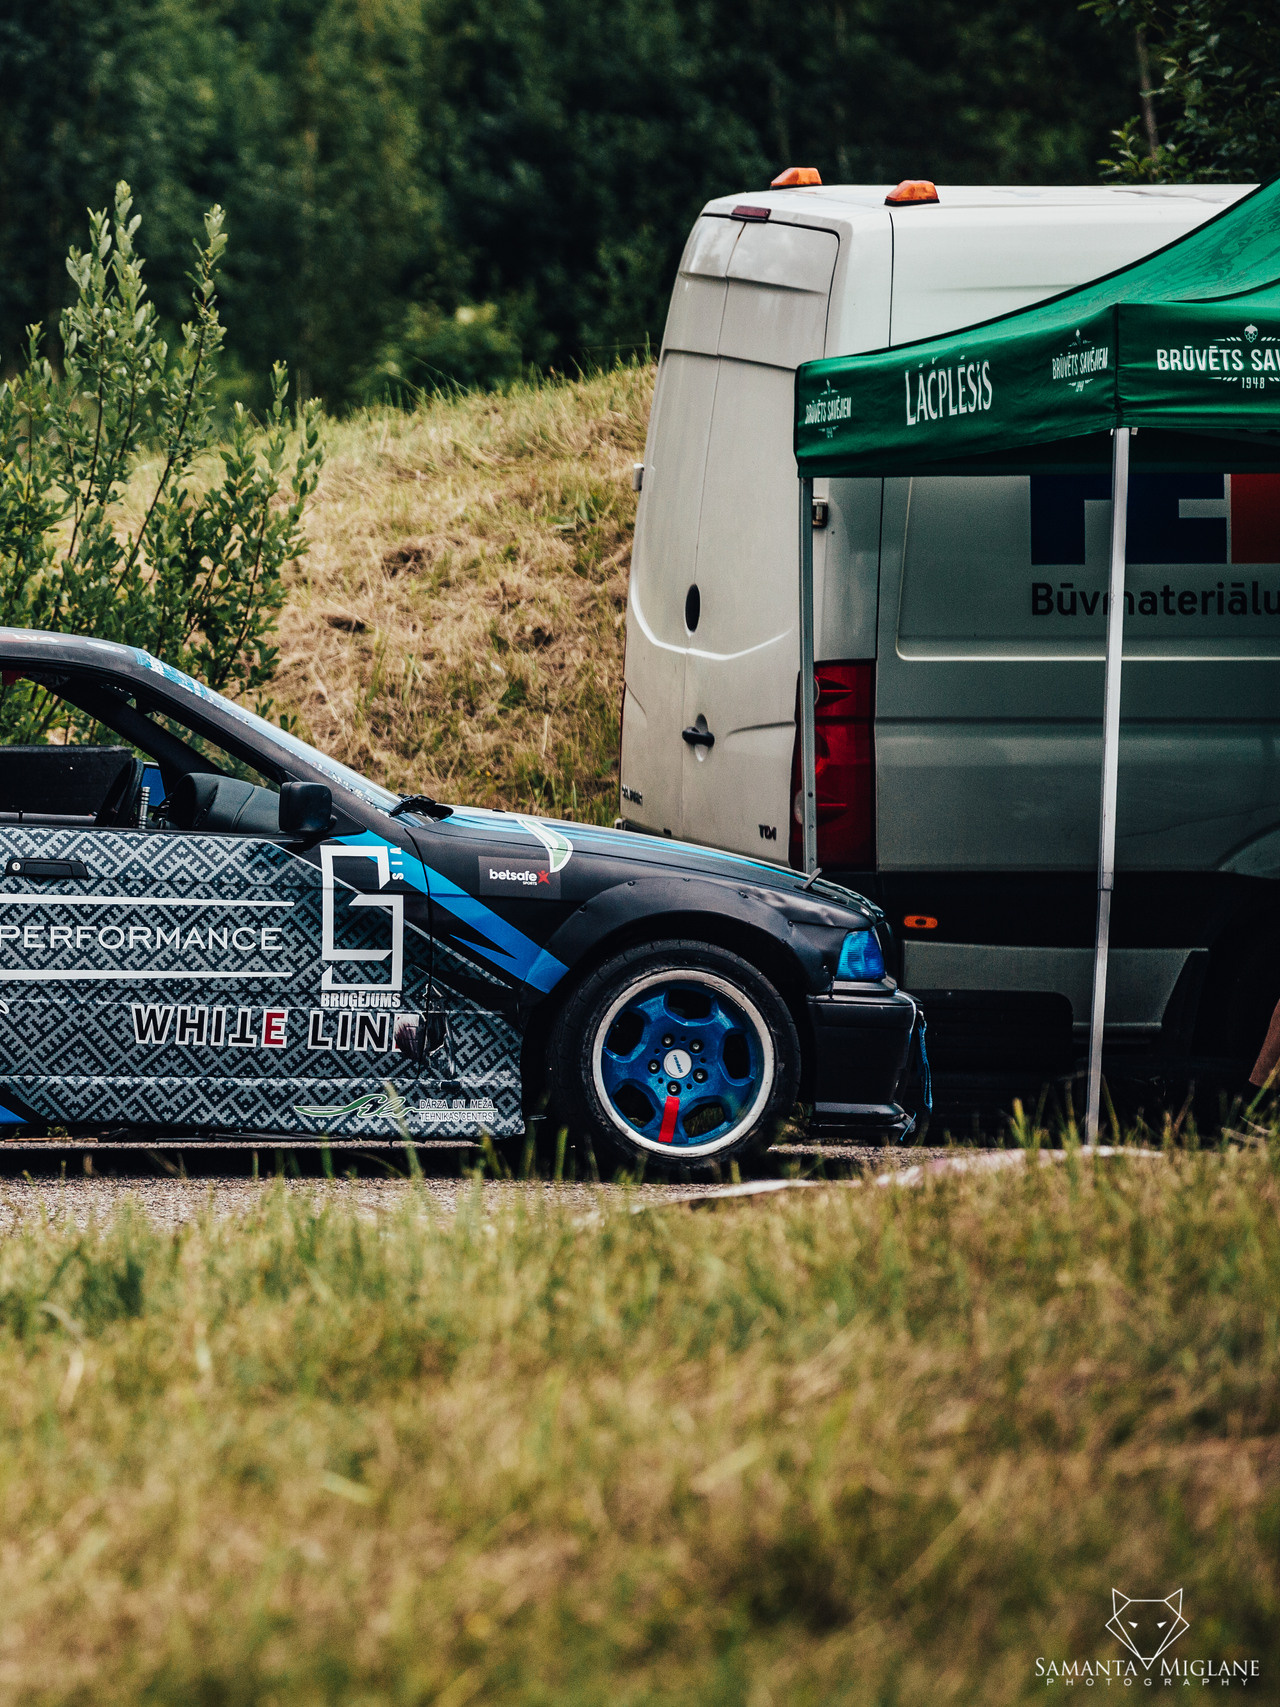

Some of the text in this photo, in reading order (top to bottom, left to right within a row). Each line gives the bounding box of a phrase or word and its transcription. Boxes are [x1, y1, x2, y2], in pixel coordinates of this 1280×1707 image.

[1156, 345, 1245, 371] BRŪVĒTS
[1241, 376, 1266, 389] 1948
[389, 846, 404, 881] SIA
[489, 868, 538, 882] betsafe
[131, 1003, 290, 1049] WHITE
[419, 1096, 495, 1110] DĀRZA UN MEŽA
[420, 1110, 495, 1122] TEHNIKAS CENTRS
